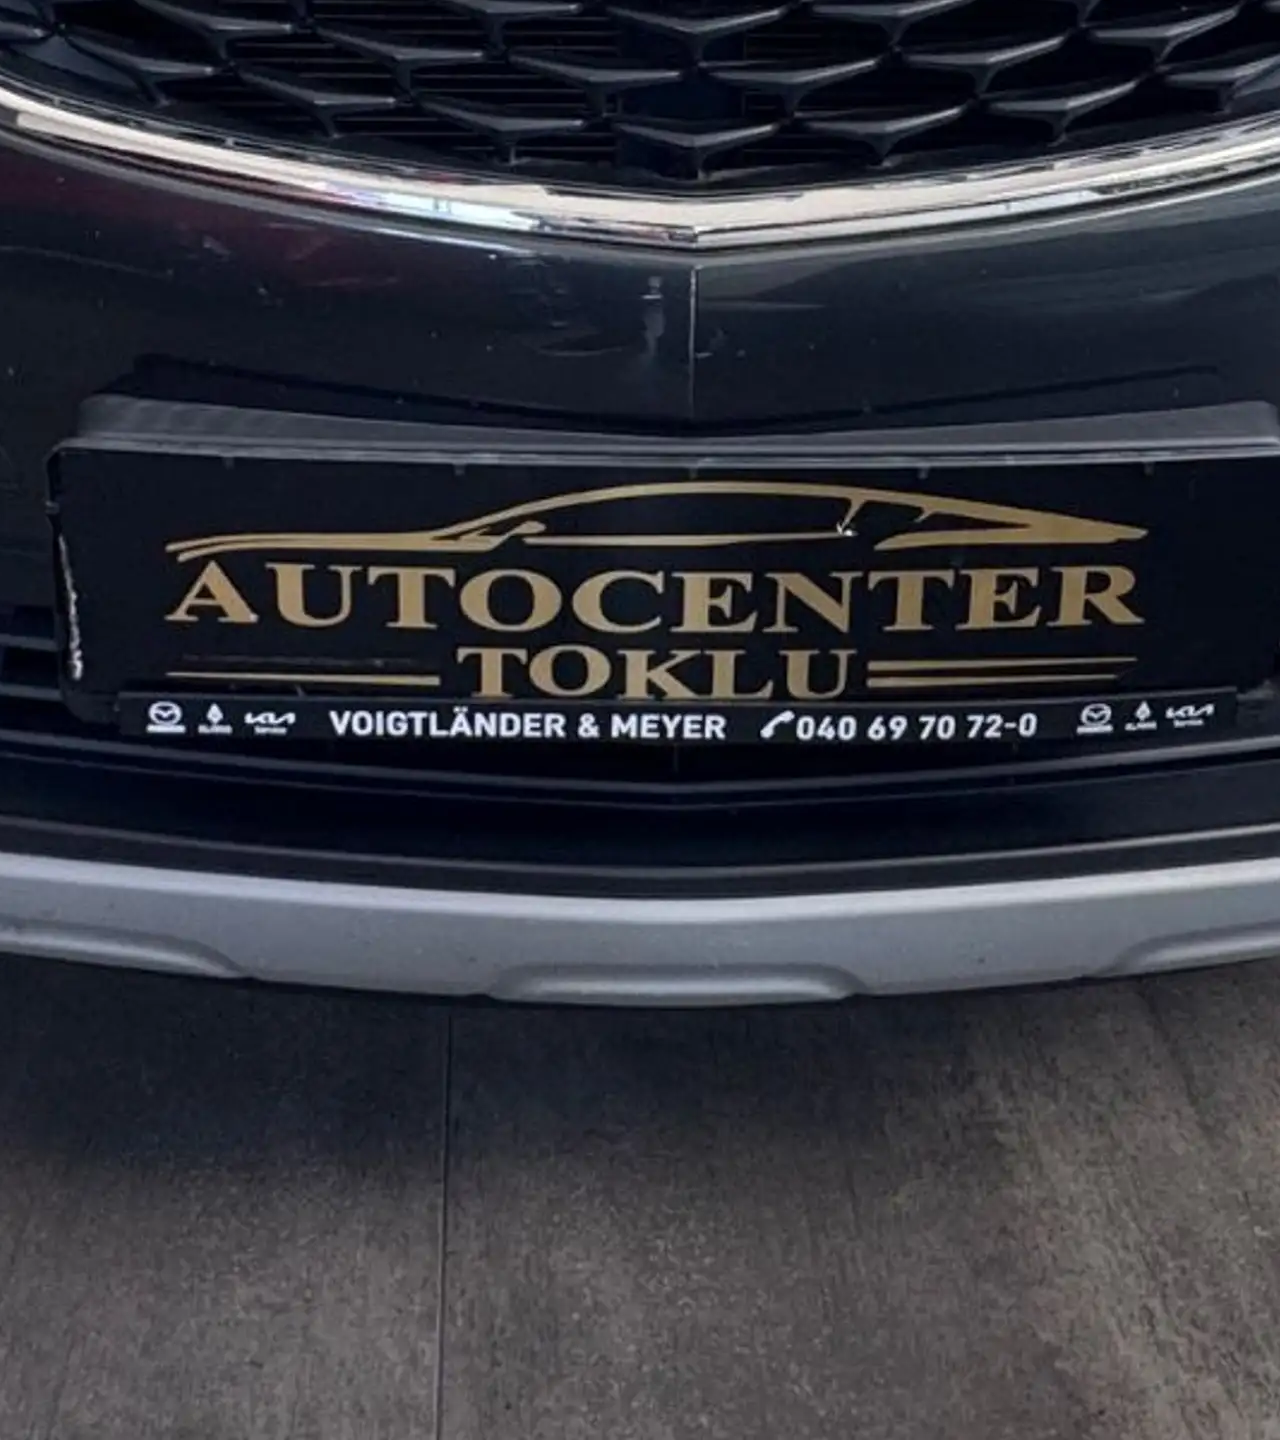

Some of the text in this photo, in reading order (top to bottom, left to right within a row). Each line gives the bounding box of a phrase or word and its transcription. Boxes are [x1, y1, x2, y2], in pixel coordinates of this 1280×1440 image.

[164, 561, 1144, 634] AUTOCENTER
[457, 644, 857, 700] TOKLU
[328, 706, 727, 740] VOIGTLÄNDER & MEYER
[795, 711, 1038, 741] 040 69 70 72-0
